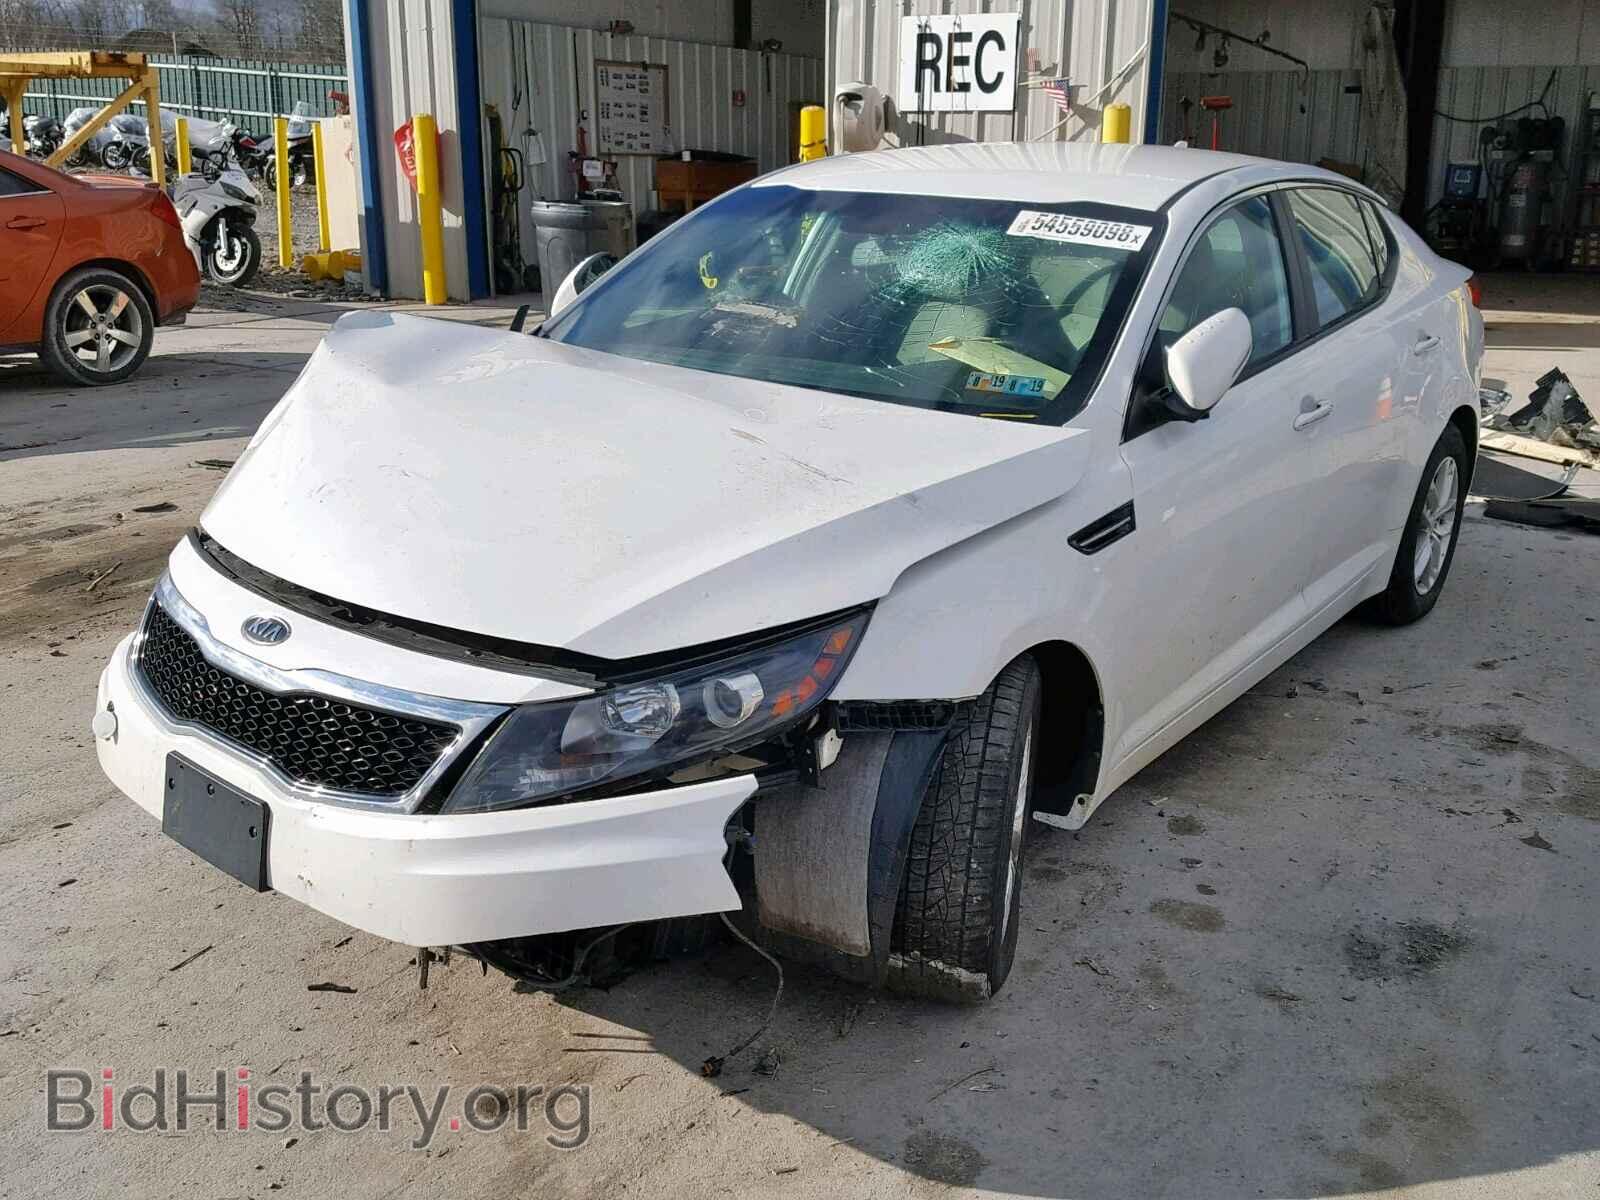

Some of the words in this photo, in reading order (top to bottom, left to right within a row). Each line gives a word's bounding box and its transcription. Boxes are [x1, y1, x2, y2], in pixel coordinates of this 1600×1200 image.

[914, 29, 1006, 94] REC
[991, 375, 1006, 388] 19
[1030, 379, 1045, 393] 19
[247, 617, 281, 641] KIA
